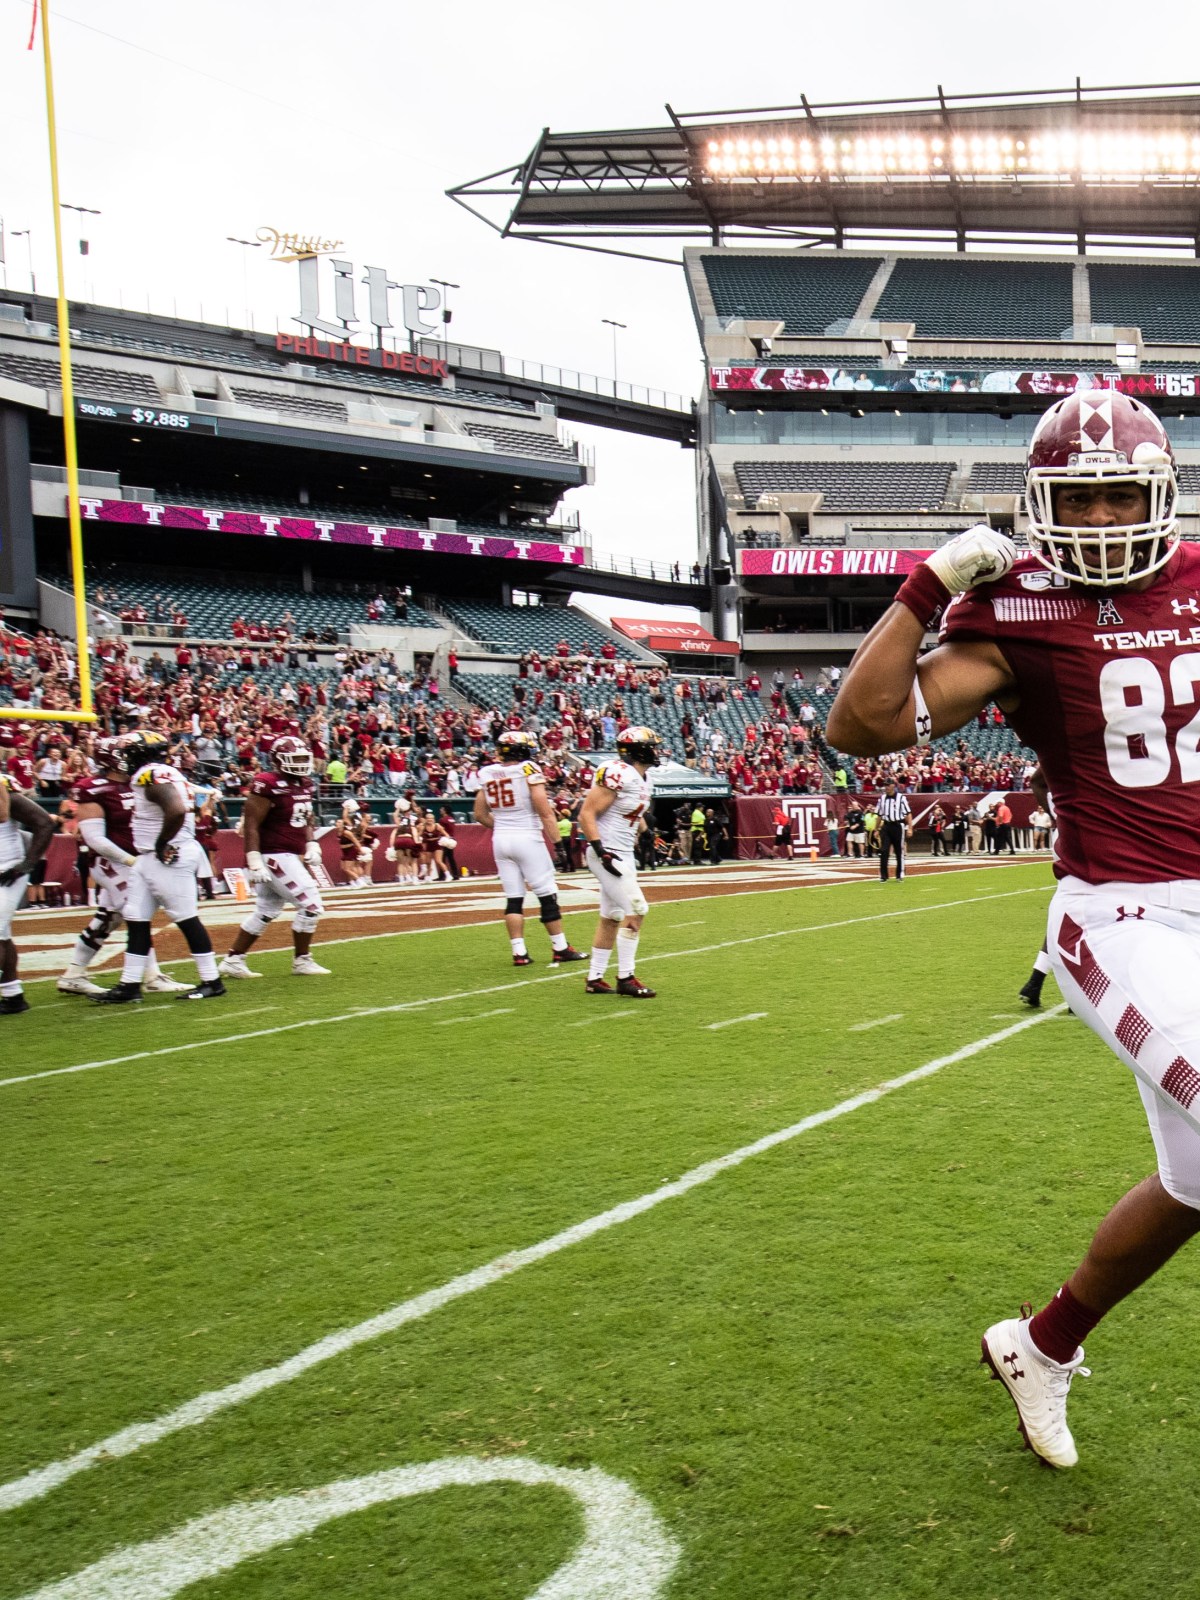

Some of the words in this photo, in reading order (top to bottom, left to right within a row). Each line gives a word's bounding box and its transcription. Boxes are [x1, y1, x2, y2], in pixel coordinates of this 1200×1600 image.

[256, 227, 344, 255] Miller
[291, 256, 441, 339] Lite
[276, 333, 370, 365] PHLITE
[382, 351, 449, 378] DECK
[1154, 374, 1195, 396] #65
[131, 408, 189, 428] $9,885
[771, 551, 834, 574] OWLS
[842, 551, 897, 574] WIN!
[625, 624, 701, 636] xfinity
[680, 640, 711, 652] xfinity
[487, 778, 515, 809] 96
[623, 803, 645, 827] 4
